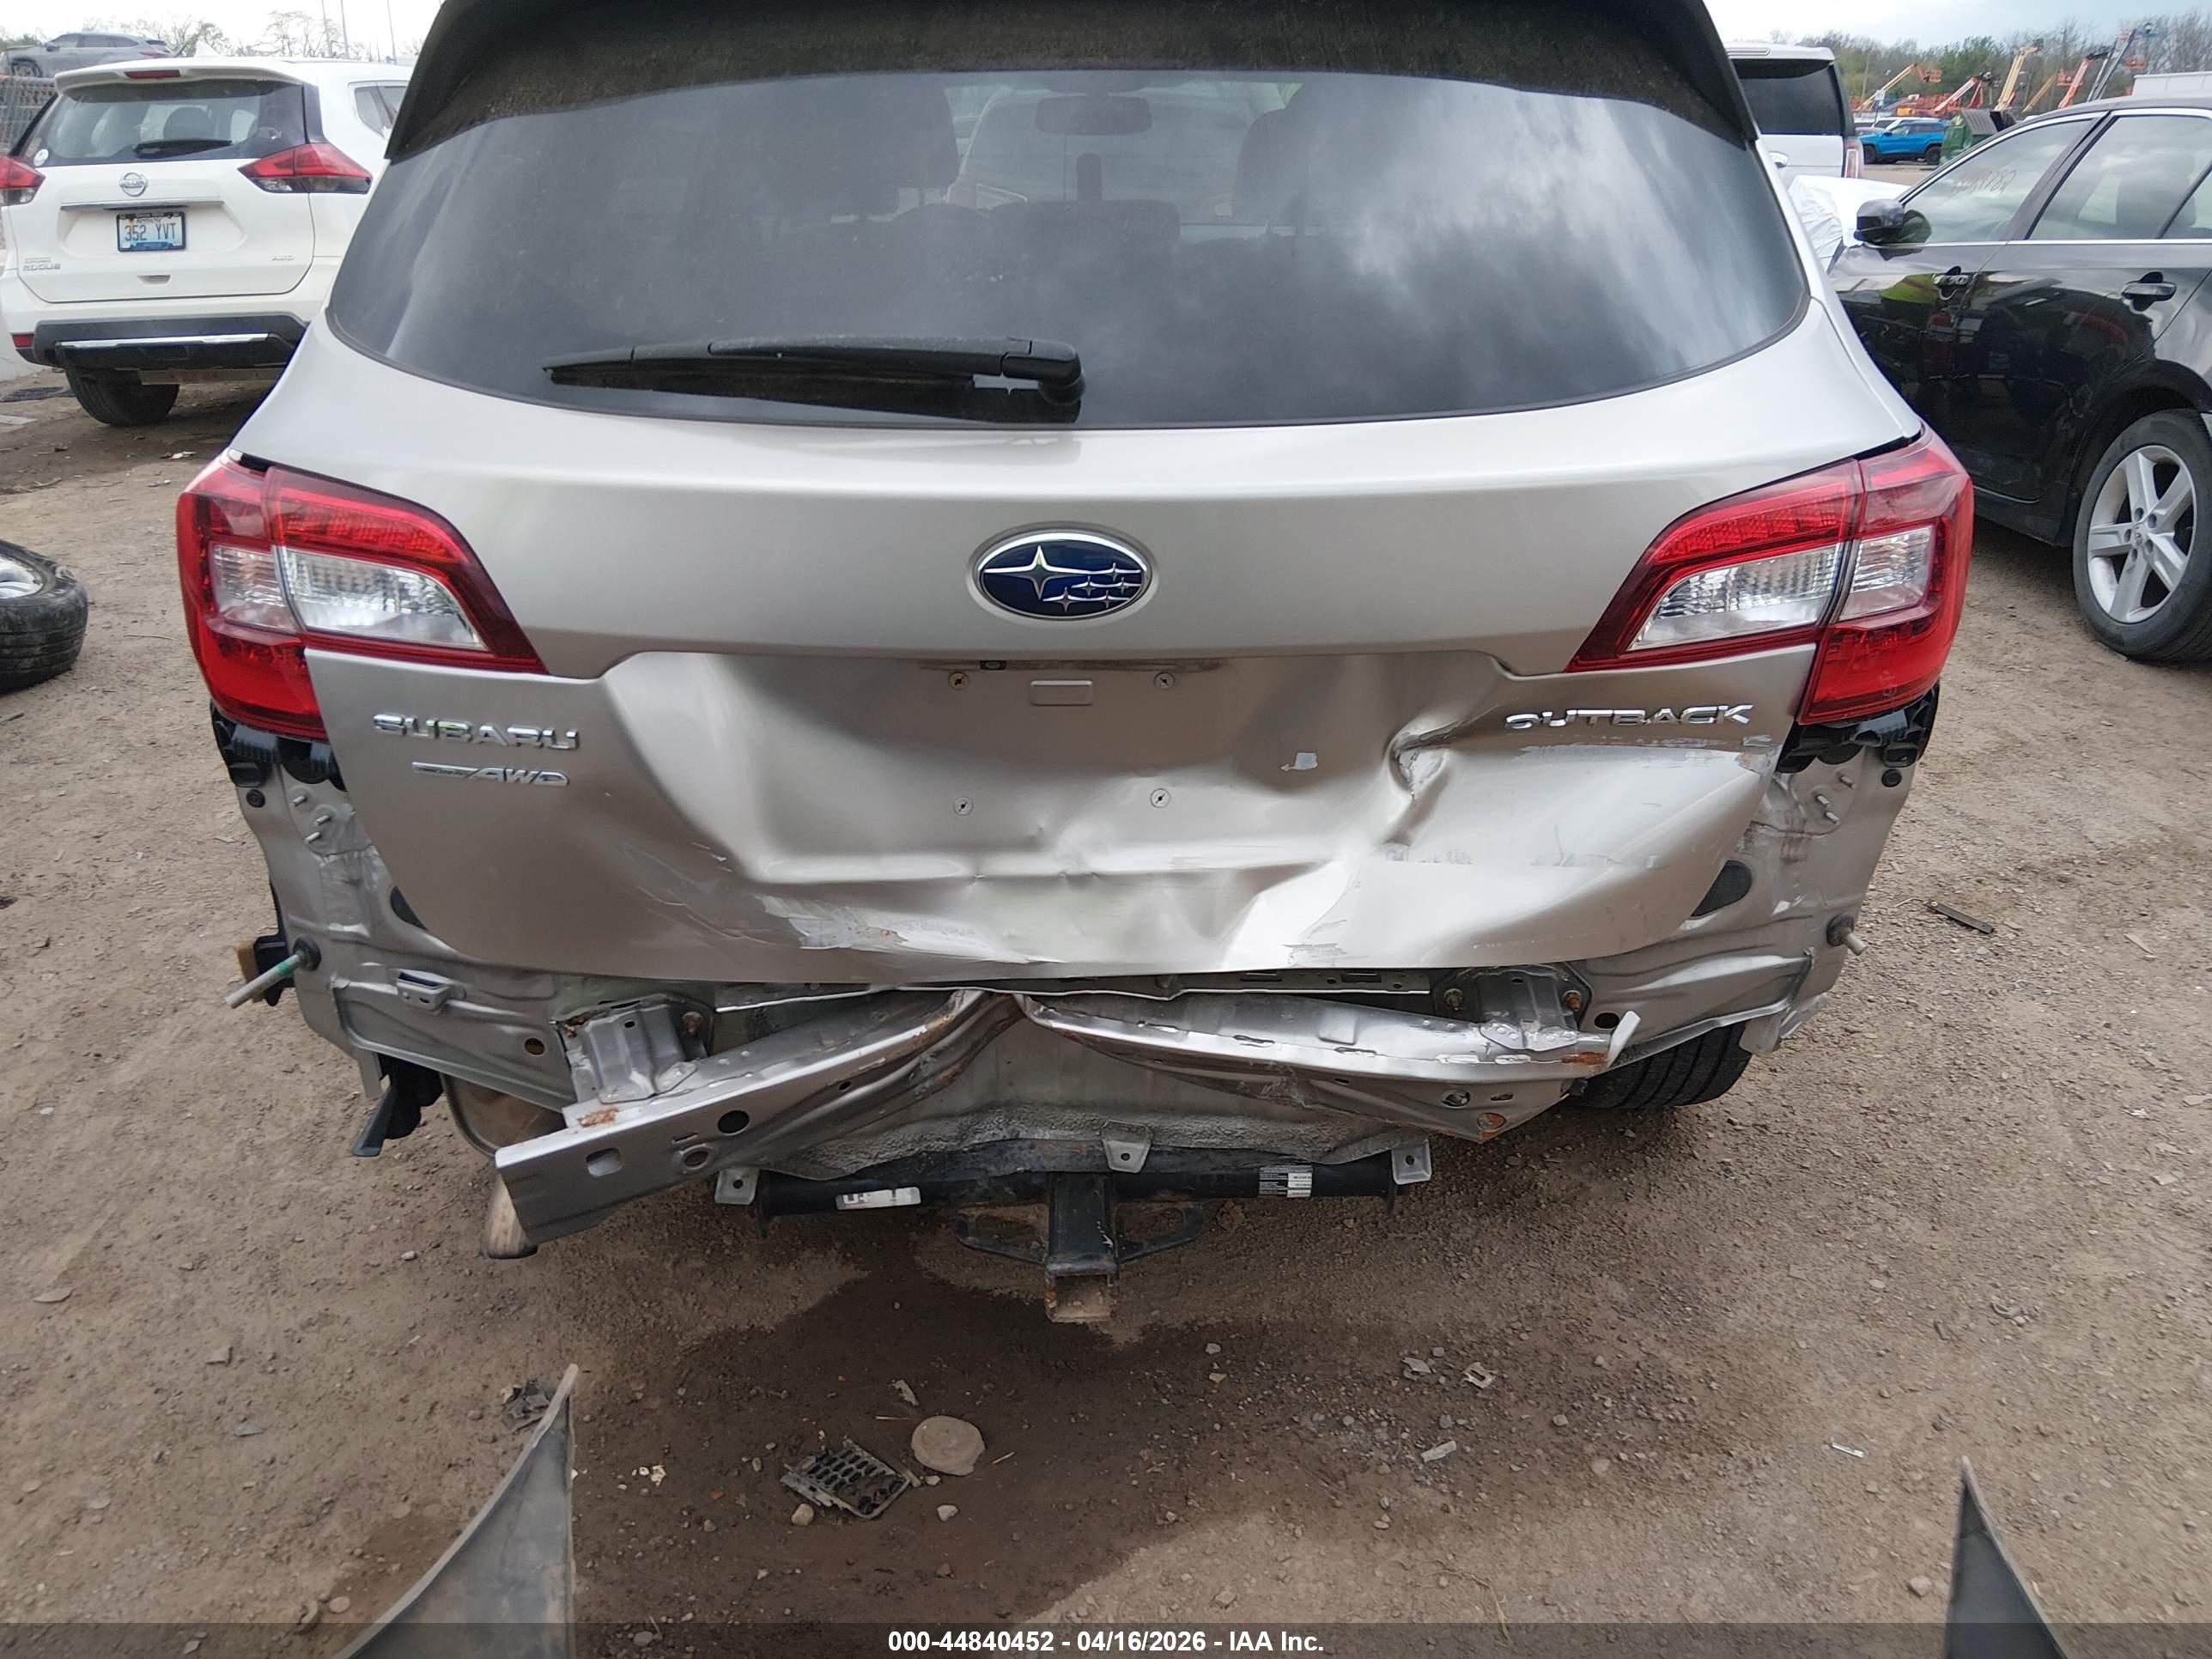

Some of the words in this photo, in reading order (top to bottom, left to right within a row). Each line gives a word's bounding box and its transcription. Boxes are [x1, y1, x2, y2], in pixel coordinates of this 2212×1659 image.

[125, 224, 147, 240] 352
[155, 222, 177, 240] YVT
[1504, 704, 1753, 729] OUTBACK
[373, 714, 580, 750] SUBARU
[469, 767, 569, 787] AWD
